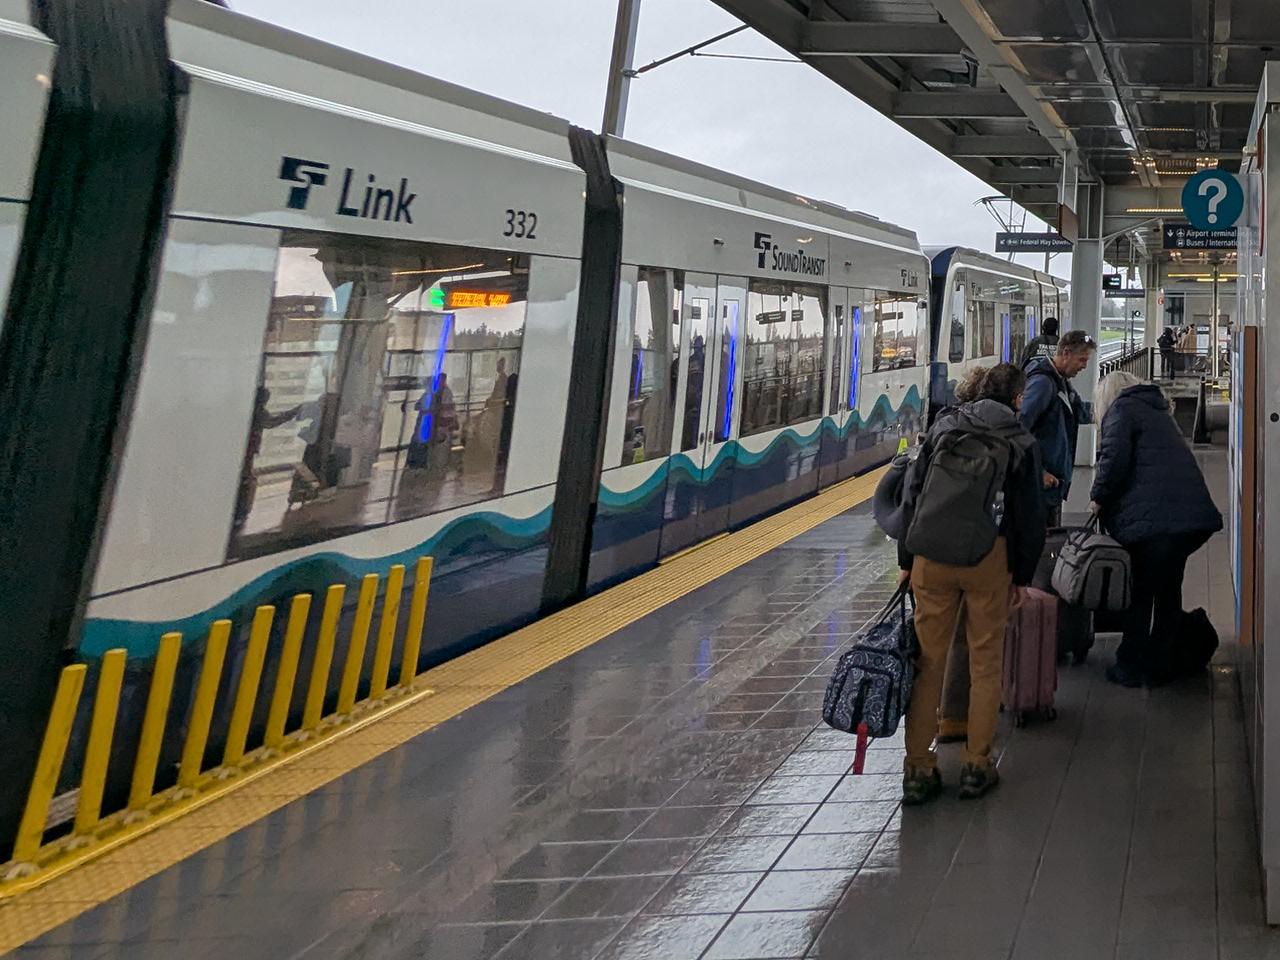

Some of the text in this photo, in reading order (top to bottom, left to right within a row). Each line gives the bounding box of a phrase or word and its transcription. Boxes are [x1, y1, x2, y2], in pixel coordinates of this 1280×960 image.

[335, 167, 417, 225] Link
[503, 209, 537, 240] 332
[1186, 230, 1209, 238] Airport
[1186, 239, 1204, 247] Buses
